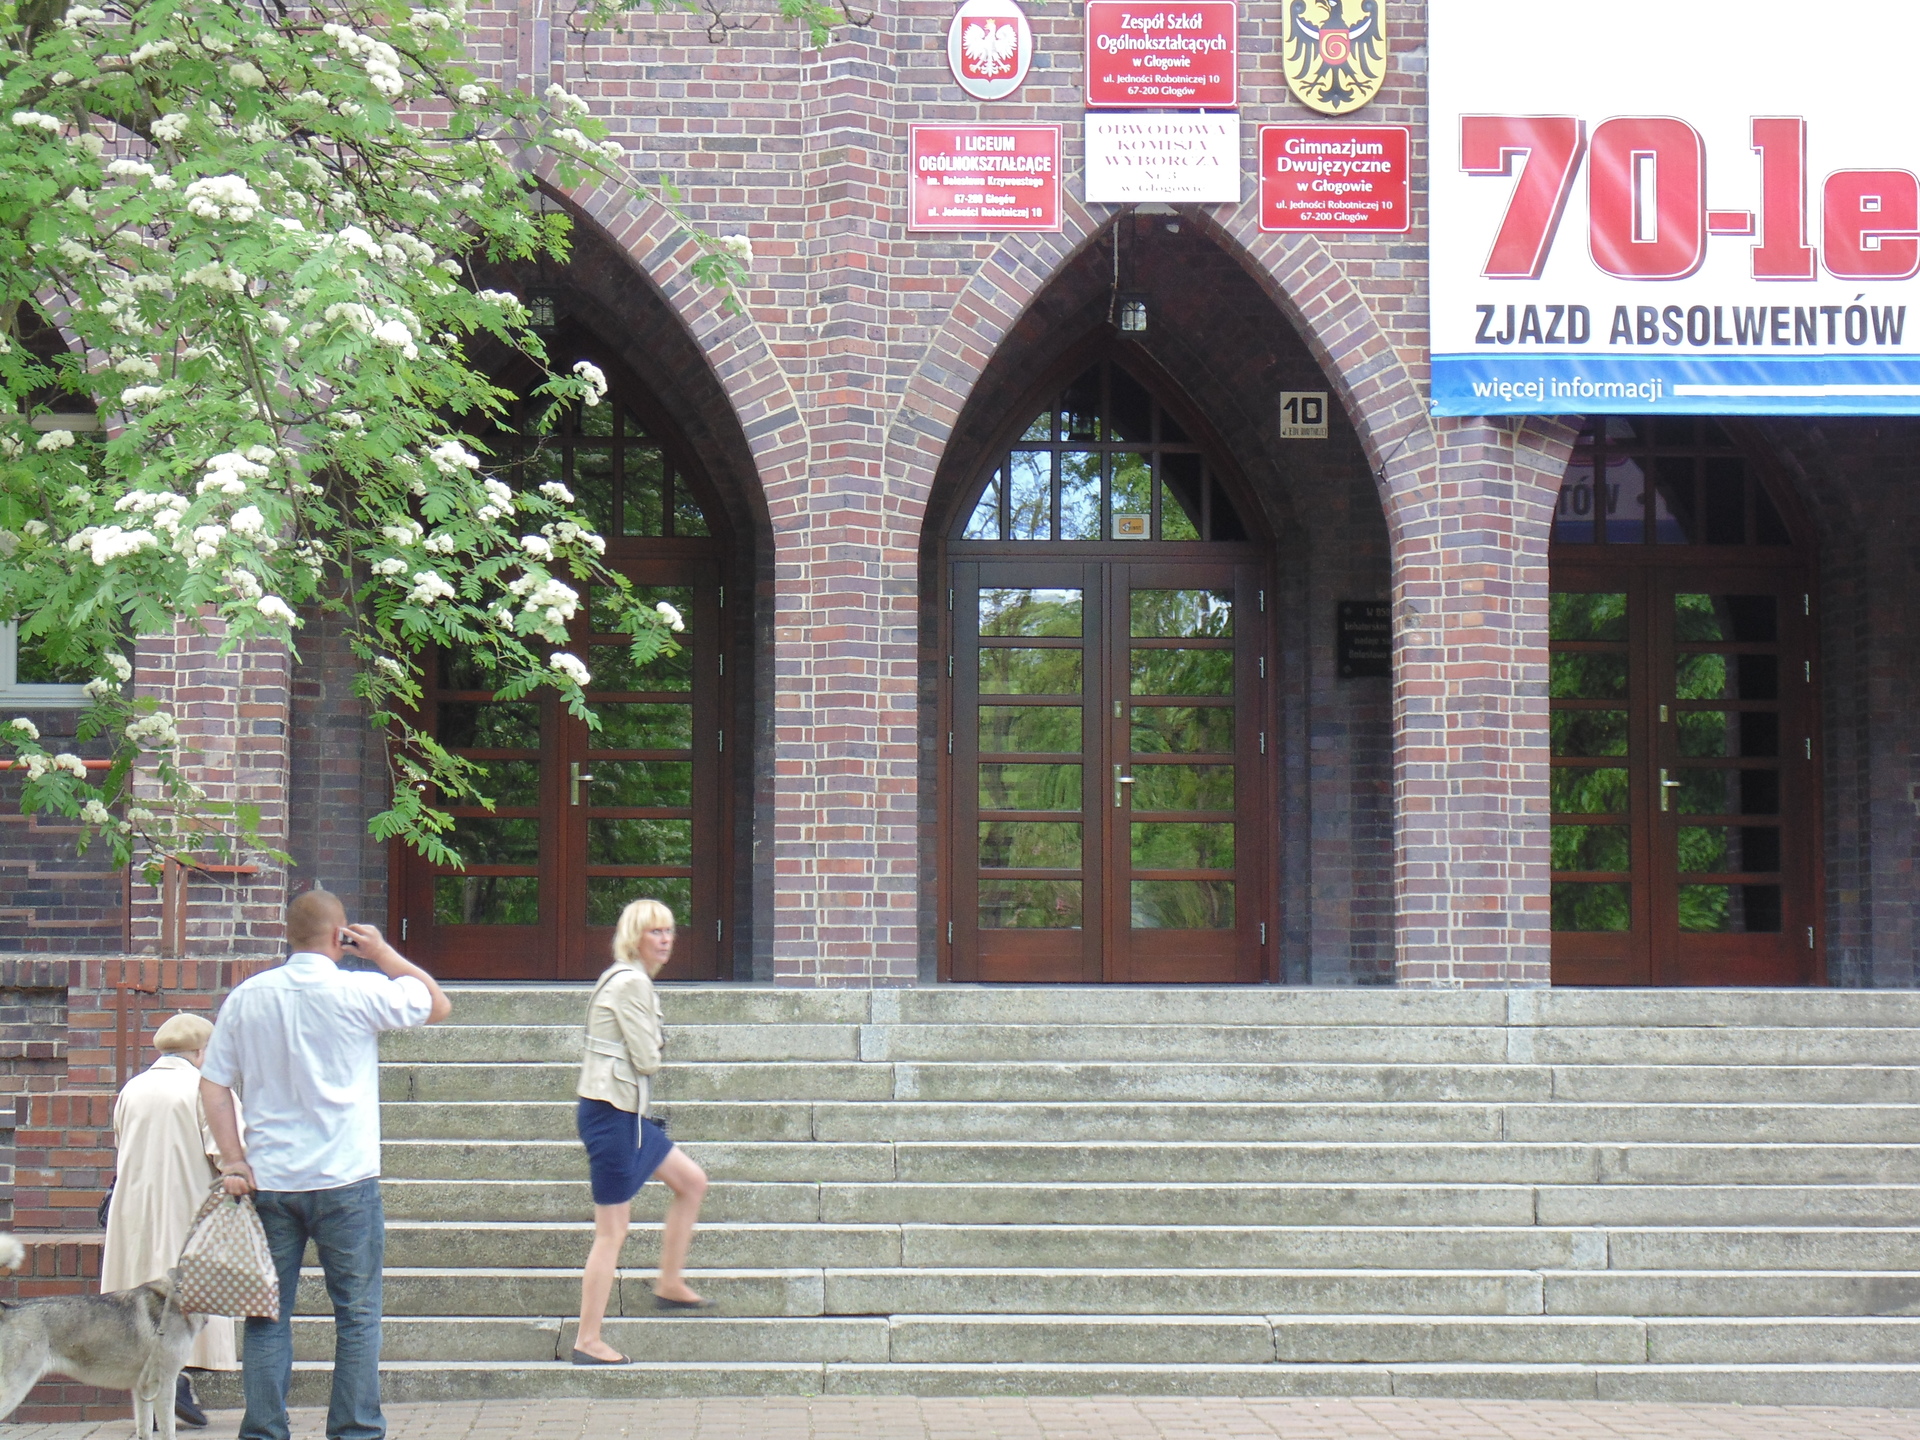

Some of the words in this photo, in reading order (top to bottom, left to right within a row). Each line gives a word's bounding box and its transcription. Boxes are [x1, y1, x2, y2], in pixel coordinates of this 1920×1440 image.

[1121, 12, 1164, 33] Zespół
[1167, 12, 1202, 29] Szkół
[1096, 34, 1226, 54] Ogólnokształcących
[1132, 58, 1142, 67] w
[1144, 55, 1191, 70] Głogowie
[1103, 74, 1114, 83] ul.
[1116, 74, 1152, 84] Jedności
[1154, 74, 1206, 86] Robotniczej
[1209, 75, 1220, 83] 10
[1128, 86, 1159, 95] 67-200
[1161, 86, 1195, 97] Głogów
[1098, 125, 1225, 134] OBWODOWA
[956, 136, 960, 151] I
[965, 136, 1015, 151] LICEUM
[1118, 140, 1207, 150] KOMISJA
[1284, 138, 1383, 158] Gimnazjum
[919, 152, 1052, 175] OGÓLNOKSZTAŁCĄCE
[1105, 156, 1219, 166] WYBORCZA
[1277, 156, 1391, 177] Dwujęzyczne
[1296, 182, 1309, 192] w
[1312, 179, 1373, 195] Głogowie
[1032, 207, 1043, 217] 10
[1276, 200, 1288, 209] ul.
[1290, 200, 1326, 210] Jedności
[1328, 200, 1379, 211] Robotniczej
[1381, 201, 1393, 209] 10
[1300, 212, 1332, 221] 67-200
[1334, 212, 1368, 223] Głogów
[1474, 303, 1591, 345] ZJAZD
[1608, 293, 1907, 346] ABSOLWENTÓW
[1472, 377, 1544, 402] więcej
[1551, 376, 1662, 402] informacji
[1283, 398, 1322, 424] 10
